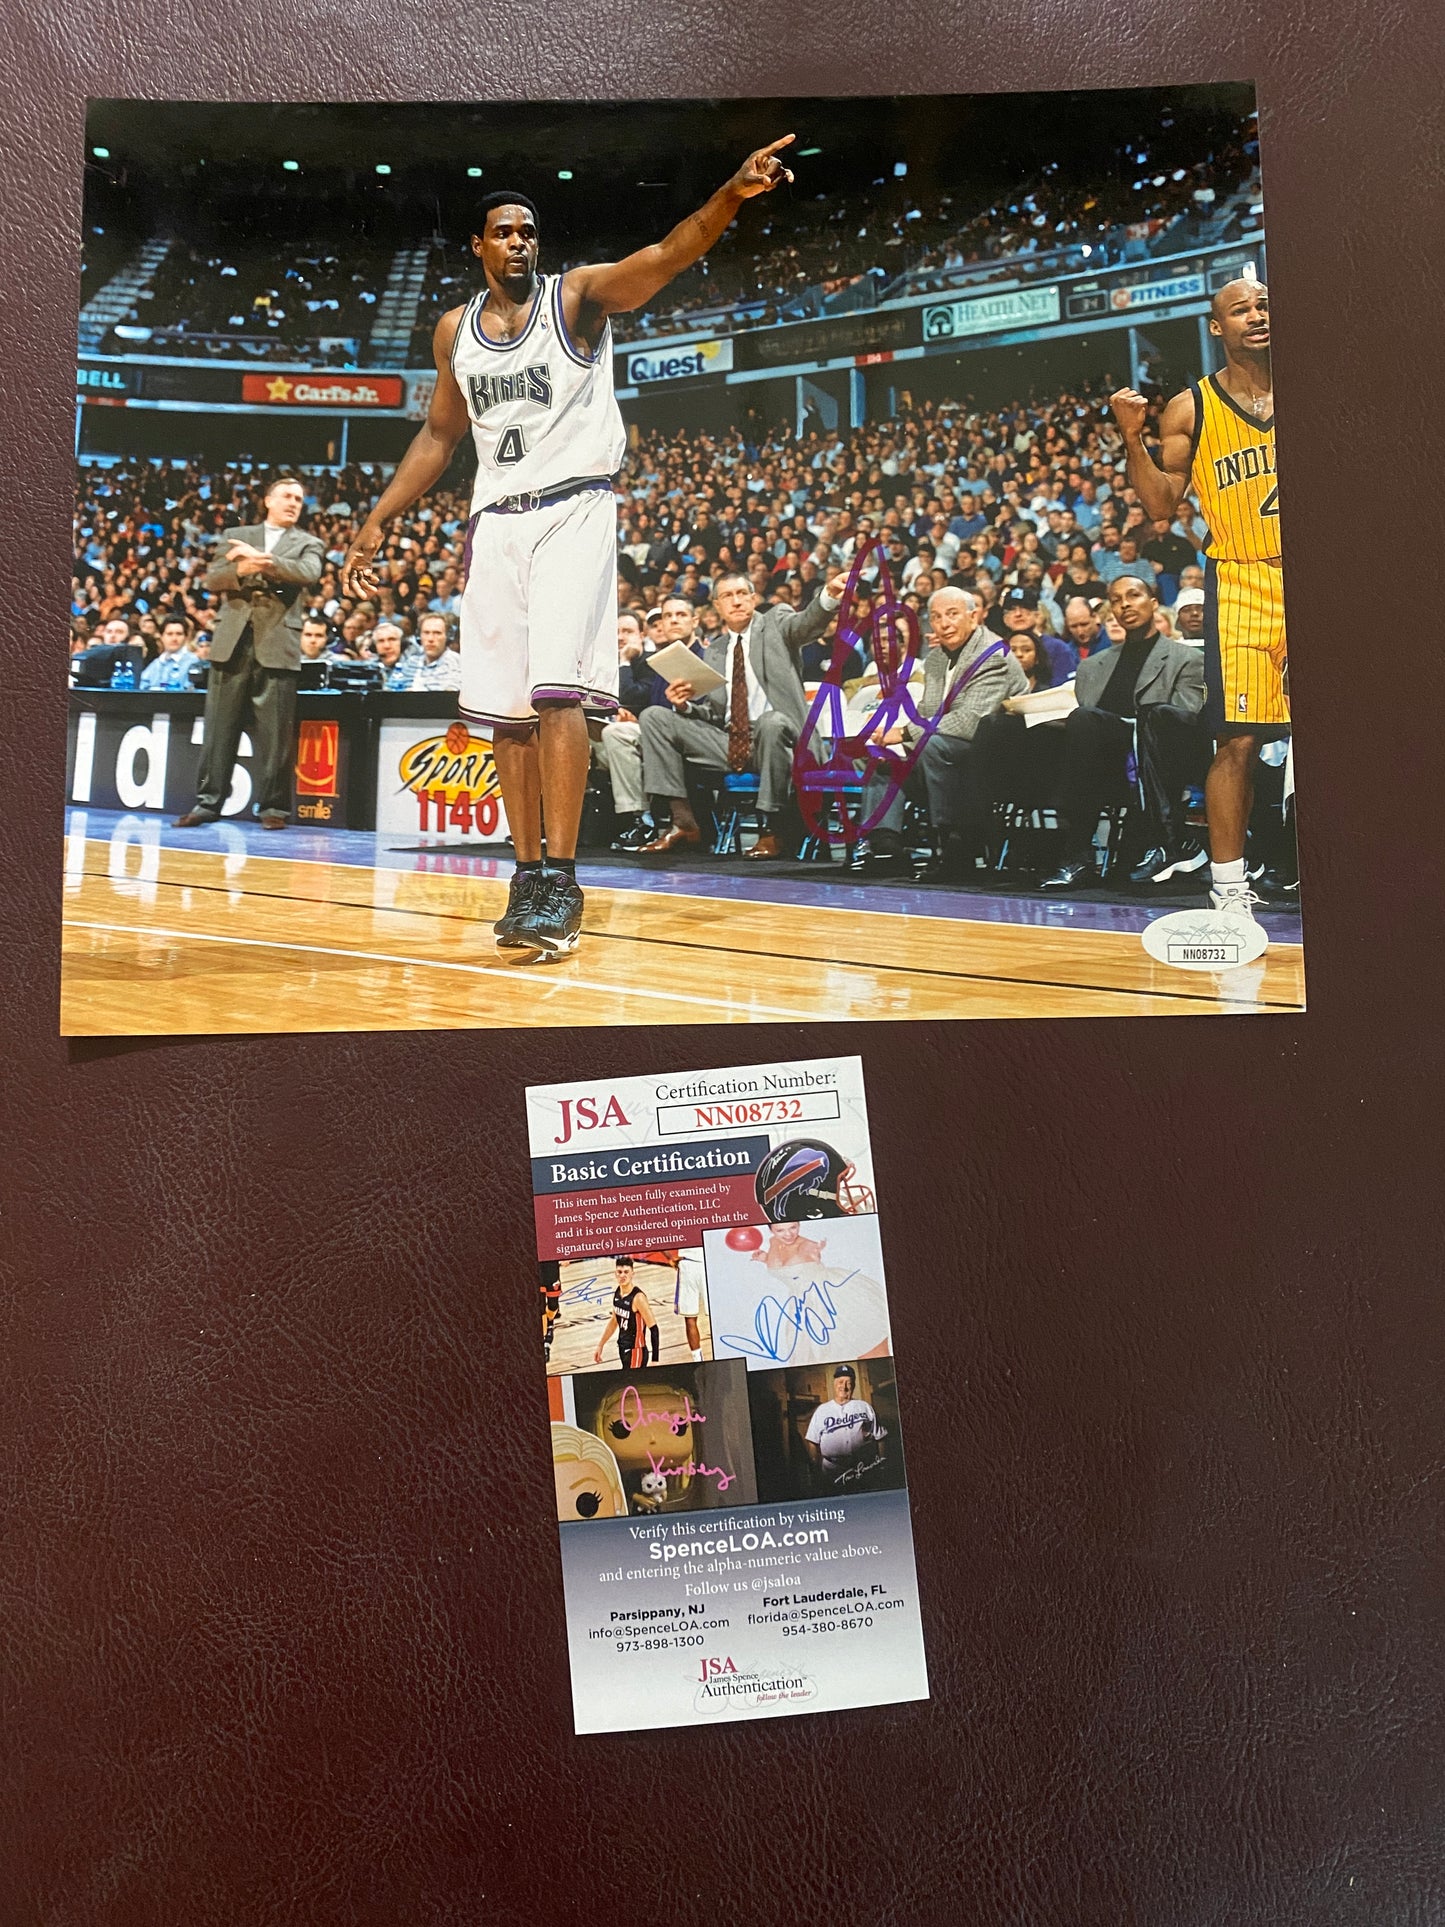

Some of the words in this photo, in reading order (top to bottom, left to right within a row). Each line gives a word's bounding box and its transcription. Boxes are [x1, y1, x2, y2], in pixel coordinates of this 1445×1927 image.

[1131, 279, 1199, 302] FITNESS
[77, 369, 127, 389] BELL
[630, 352, 706, 382] Quest
[352, 386, 380, 403] Jr.
[467, 363, 553, 420] KINGS
[494, 424, 530, 467] 4
[298, 799, 332, 820] smile
[417, 789, 499, 836] 1140
[1183, 948, 1226, 960] NN08732
[656, 1079, 758, 1101] Certification
[763, 1071, 836, 1091] Number:
[554, 1095, 632, 1144] JSA
[694, 1099, 803, 1127] NN08732
[551, 1161, 608, 1184] Basic
[613, 1148, 751, 1177] Certification
[553, 1199, 574, 1209] This
[576, 1197, 598, 1207] item
[600, 1195, 617, 1205] has
[619, 1193, 642, 1203] been
[645, 1189, 667, 1201] fully
[669, 1184, 716, 1198] examined
[718, 1183, 731, 1195] by
[554, 1214, 583, 1225] James
[585, 1211, 619, 1223] Spence
[622, 1203, 697, 1217] Authentication,
[700, 1198, 721, 1210] LLC
[555, 1228, 573, 1239] and
[576, 1227, 583, 1237] it
[586, 1226, 594, 1236] is
[596, 1226, 613, 1235] our
[615, 1218, 668, 1233] considered
[671, 1216, 709, 1230] opinion
[711, 1213, 731, 1223] that
[733, 1211, 749, 1221] the
[556, 1239, 614, 1256] signature(s)
[616, 1237, 643, 1248] is/are
[645, 1233, 687, 1248] genuine.
[620, 1318, 629, 1331] 14
[822, 1412, 868, 1431] Dodgers
[630, 1524, 668, 1541] Verify
[672, 1522, 696, 1536] this
[700, 1515, 776, 1534] certification
[780, 1512, 795, 1528] by
[798, 1508, 846, 1522] visiting
[650, 1529, 829, 1562] SpenceLOA.com
[599, 1568, 623, 1582] and
[626, 1564, 680, 1580] entering
[684, 1561, 705, 1575] the
[707, 1552, 801, 1576] alpha-numeric
[805, 1548, 839, 1562] value
[841, 1544, 882, 1558] above.
[685, 1581, 729, 1596] Follow
[733, 1581, 748, 1591] us
[751, 1574, 801, 1593] @jsaloa
[763, 1595, 790, 1607] Fort
[793, 1587, 868, 1604] Lauderdale,
[871, 1584, 887, 1595] FL
[610, 1607, 685, 1621] Parsippany,
[689, 1604, 705, 1614] NJ
[748, 1599, 905, 1624] florida@SpenceLOA.com
[588, 1618, 730, 1639] info@SpenceLOA.com
[782, 1617, 873, 1636] 954-380-8670
[616, 1635, 704, 1652] 973-898-1300
[698, 1656, 739, 1682] JSA
[708, 1675, 731, 1684] James
[733, 1673, 759, 1682] Spence
[756, 1694, 777, 1702] follow
[790, 1690, 812, 1698] leader
